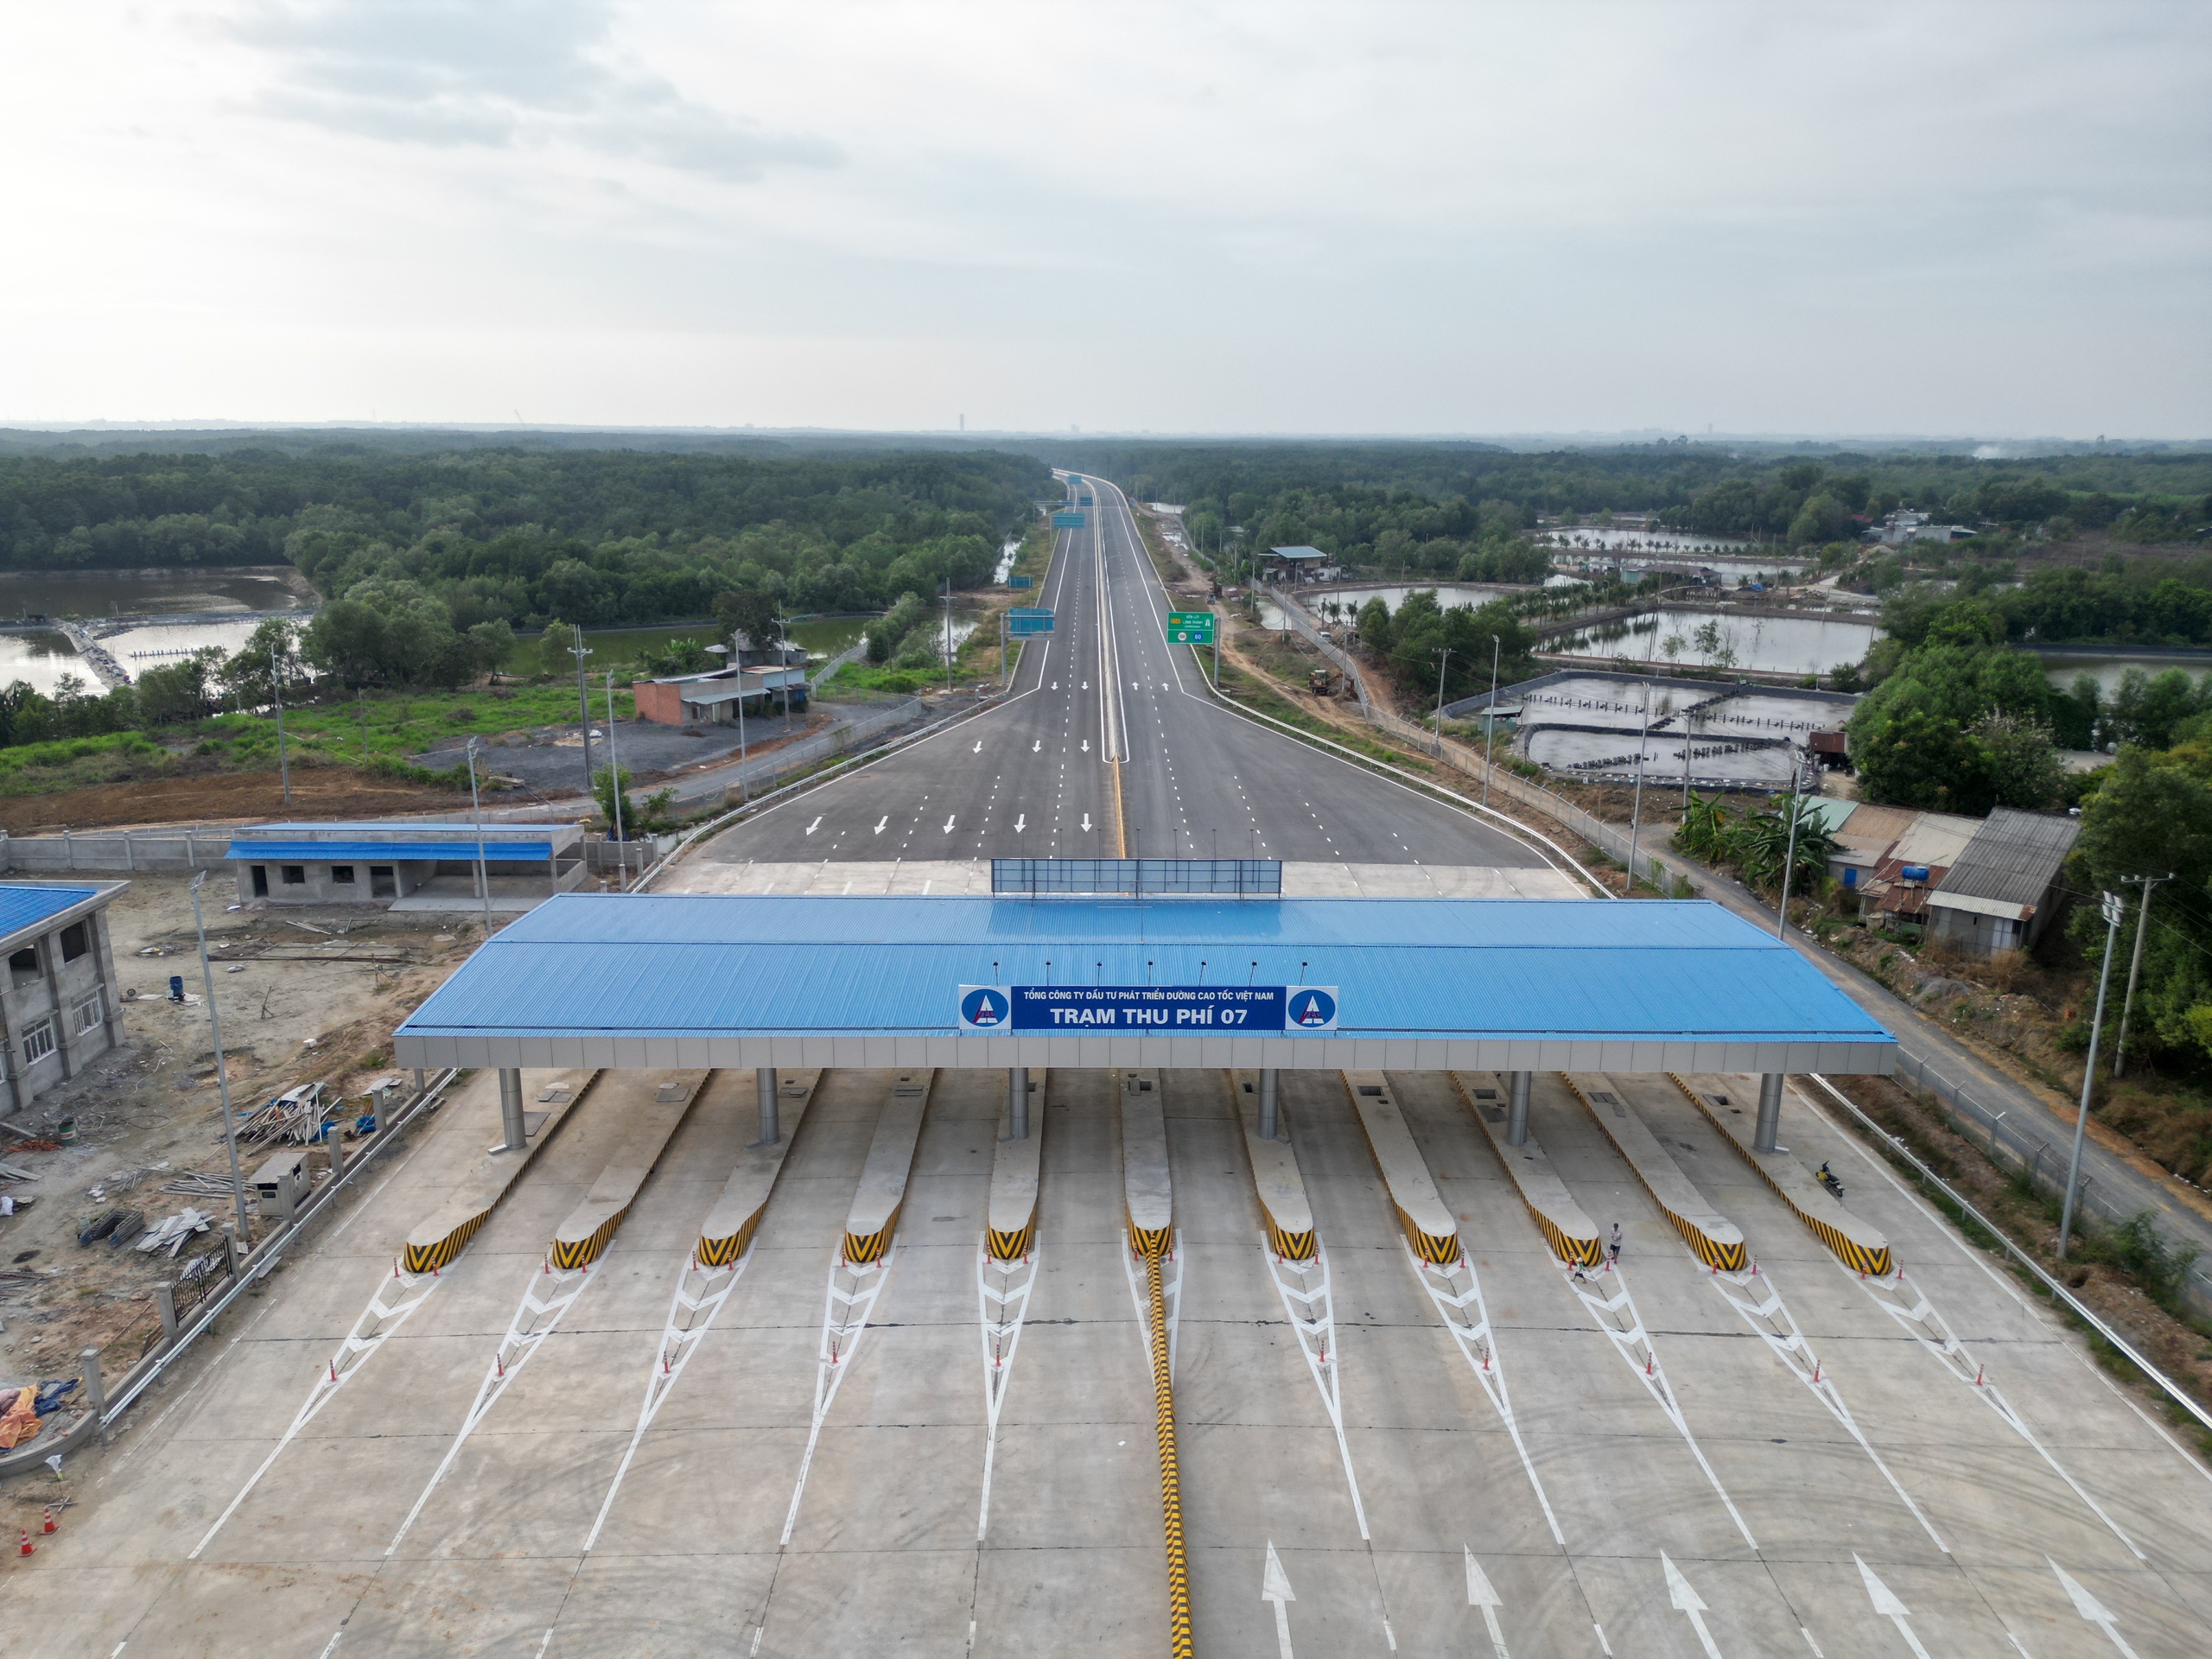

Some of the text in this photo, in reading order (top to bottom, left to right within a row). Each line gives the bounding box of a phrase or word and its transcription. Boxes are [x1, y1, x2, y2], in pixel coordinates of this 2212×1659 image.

[1024, 987, 1046, 1000] TỔNG
[1048, 989, 1071, 1000] CÔNG
[1073, 991, 1084, 1000] TY
[1105, 990, 1117, 1000] TƯ
[1118, 989, 1141, 1000] PHÁT
[1141, 988, 1165, 1000] TRIỂN
[1166, 989, 1196, 1001] ĐƯỜNG
[1198, 991, 1216, 1001] CAO
[1217, 988, 1234, 1001] TỐC
[1235, 990, 1253, 1002] VIỆT
[1255, 992, 1274, 1001] NAM
[1050, 1004, 1248, 1027] TRẠM THU PHÍ 07
